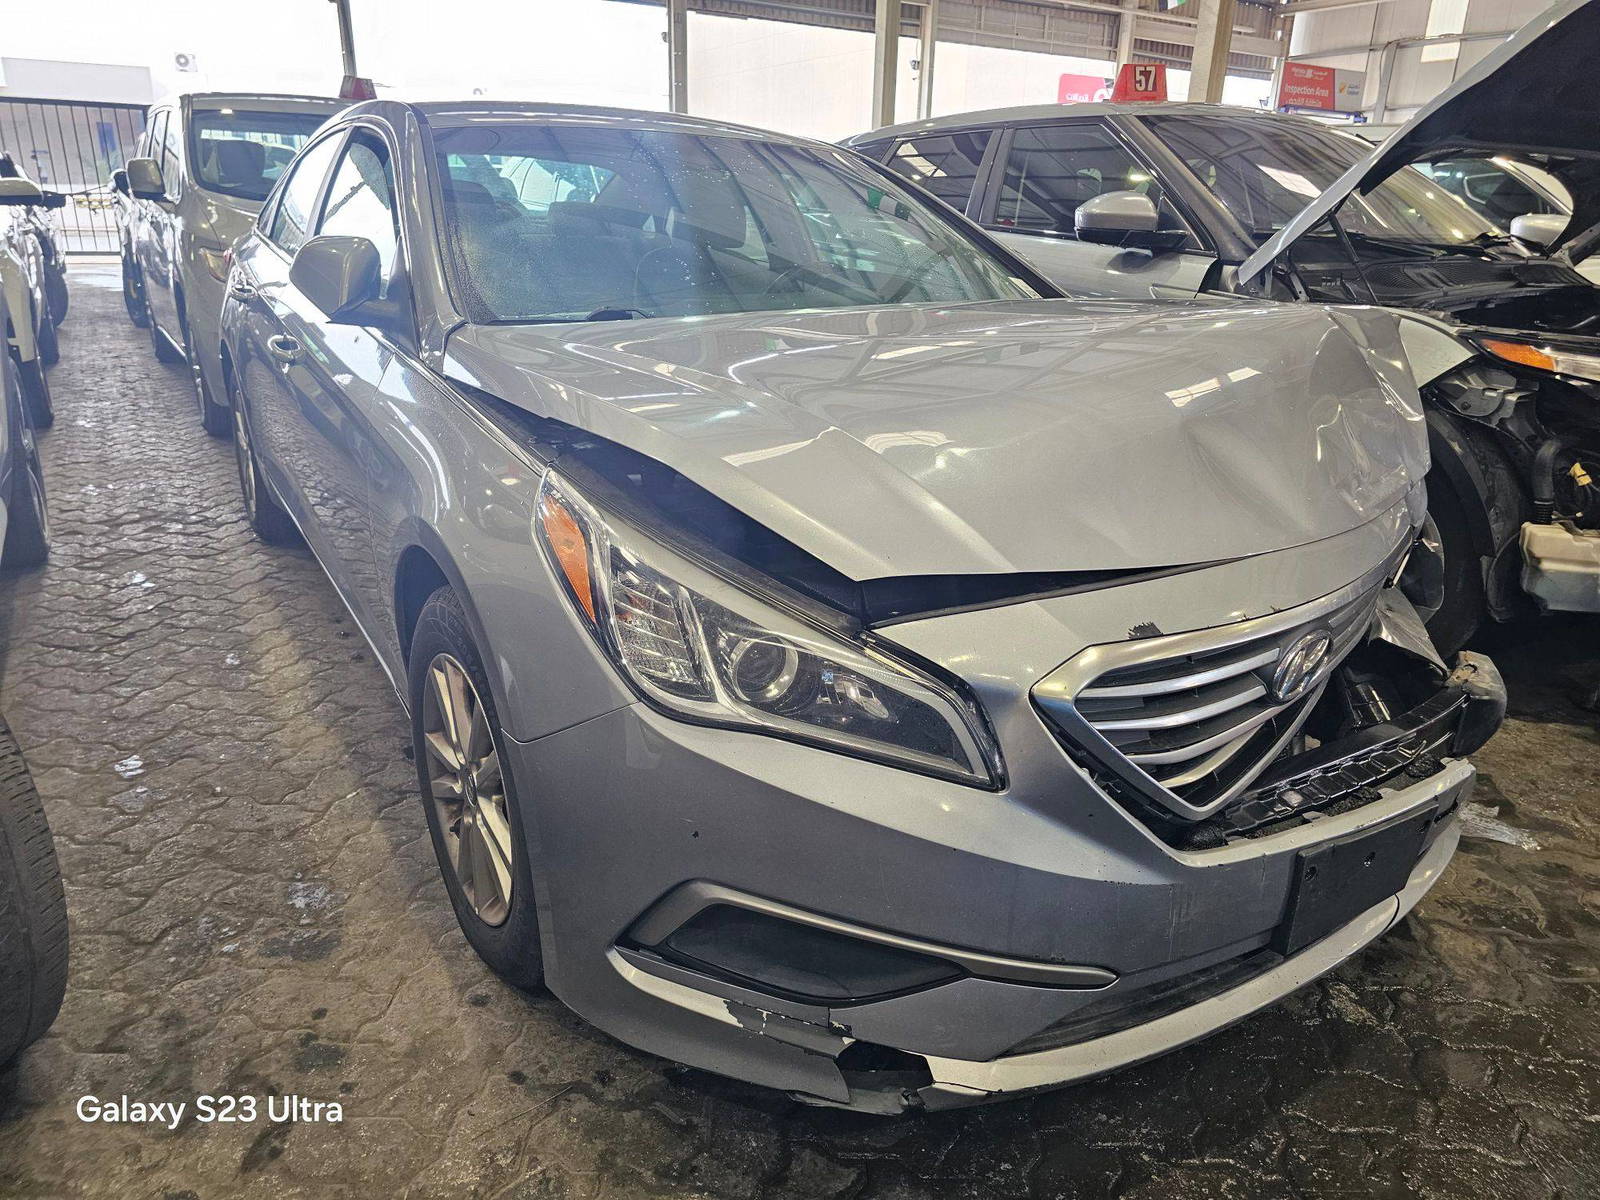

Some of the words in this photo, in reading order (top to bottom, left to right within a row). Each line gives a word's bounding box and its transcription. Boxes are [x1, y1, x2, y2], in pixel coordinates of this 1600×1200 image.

[1134, 66, 1156, 91] 57
[1285, 84, 1315, 96] Inspection
[1315, 87, 1329, 97] Area
